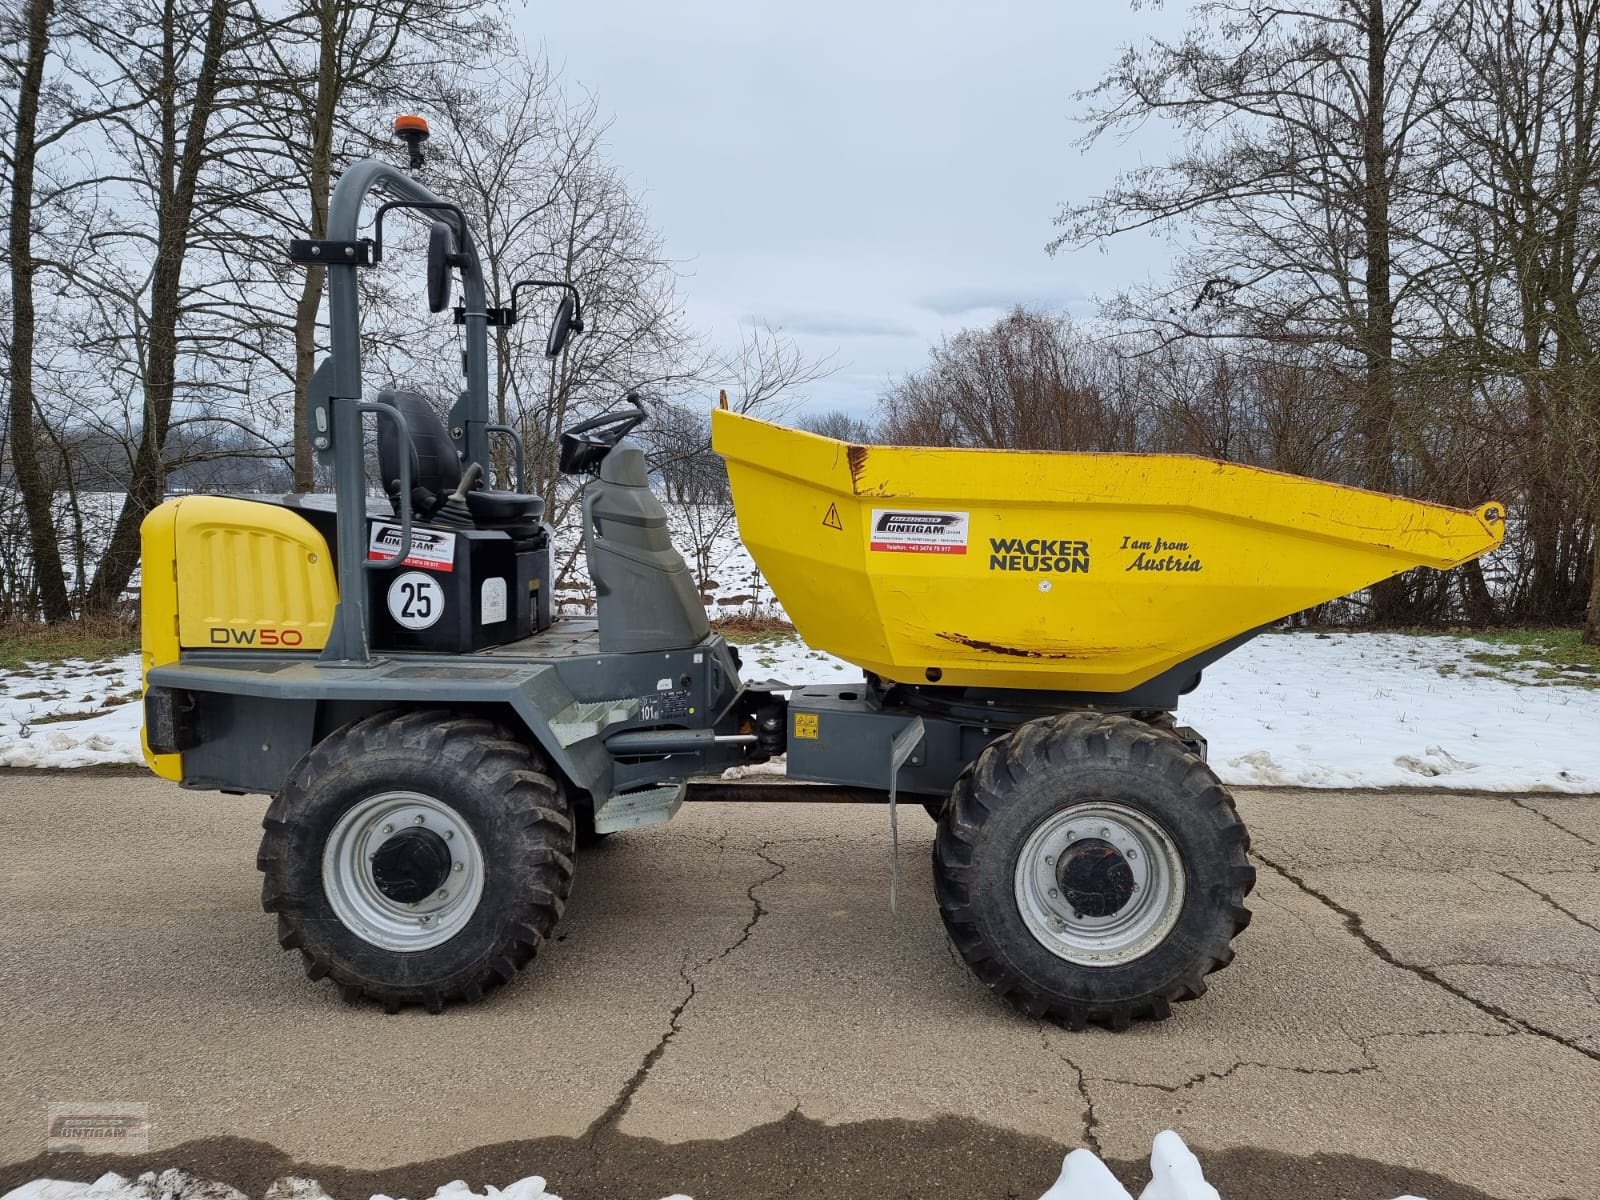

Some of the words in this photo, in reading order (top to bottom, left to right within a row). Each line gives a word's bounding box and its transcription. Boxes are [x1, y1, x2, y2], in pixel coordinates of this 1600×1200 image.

[990, 538, 1089, 556] WACKER
[1120, 536, 1131, 549] I
[1131, 540, 1152, 549] am
[1153, 537, 1189, 554] from
[990, 555, 1089, 573] NEUSON
[1125, 552, 1202, 572] Austria
[401, 583, 431, 618] 25
[210, 628, 302, 646] DW50
